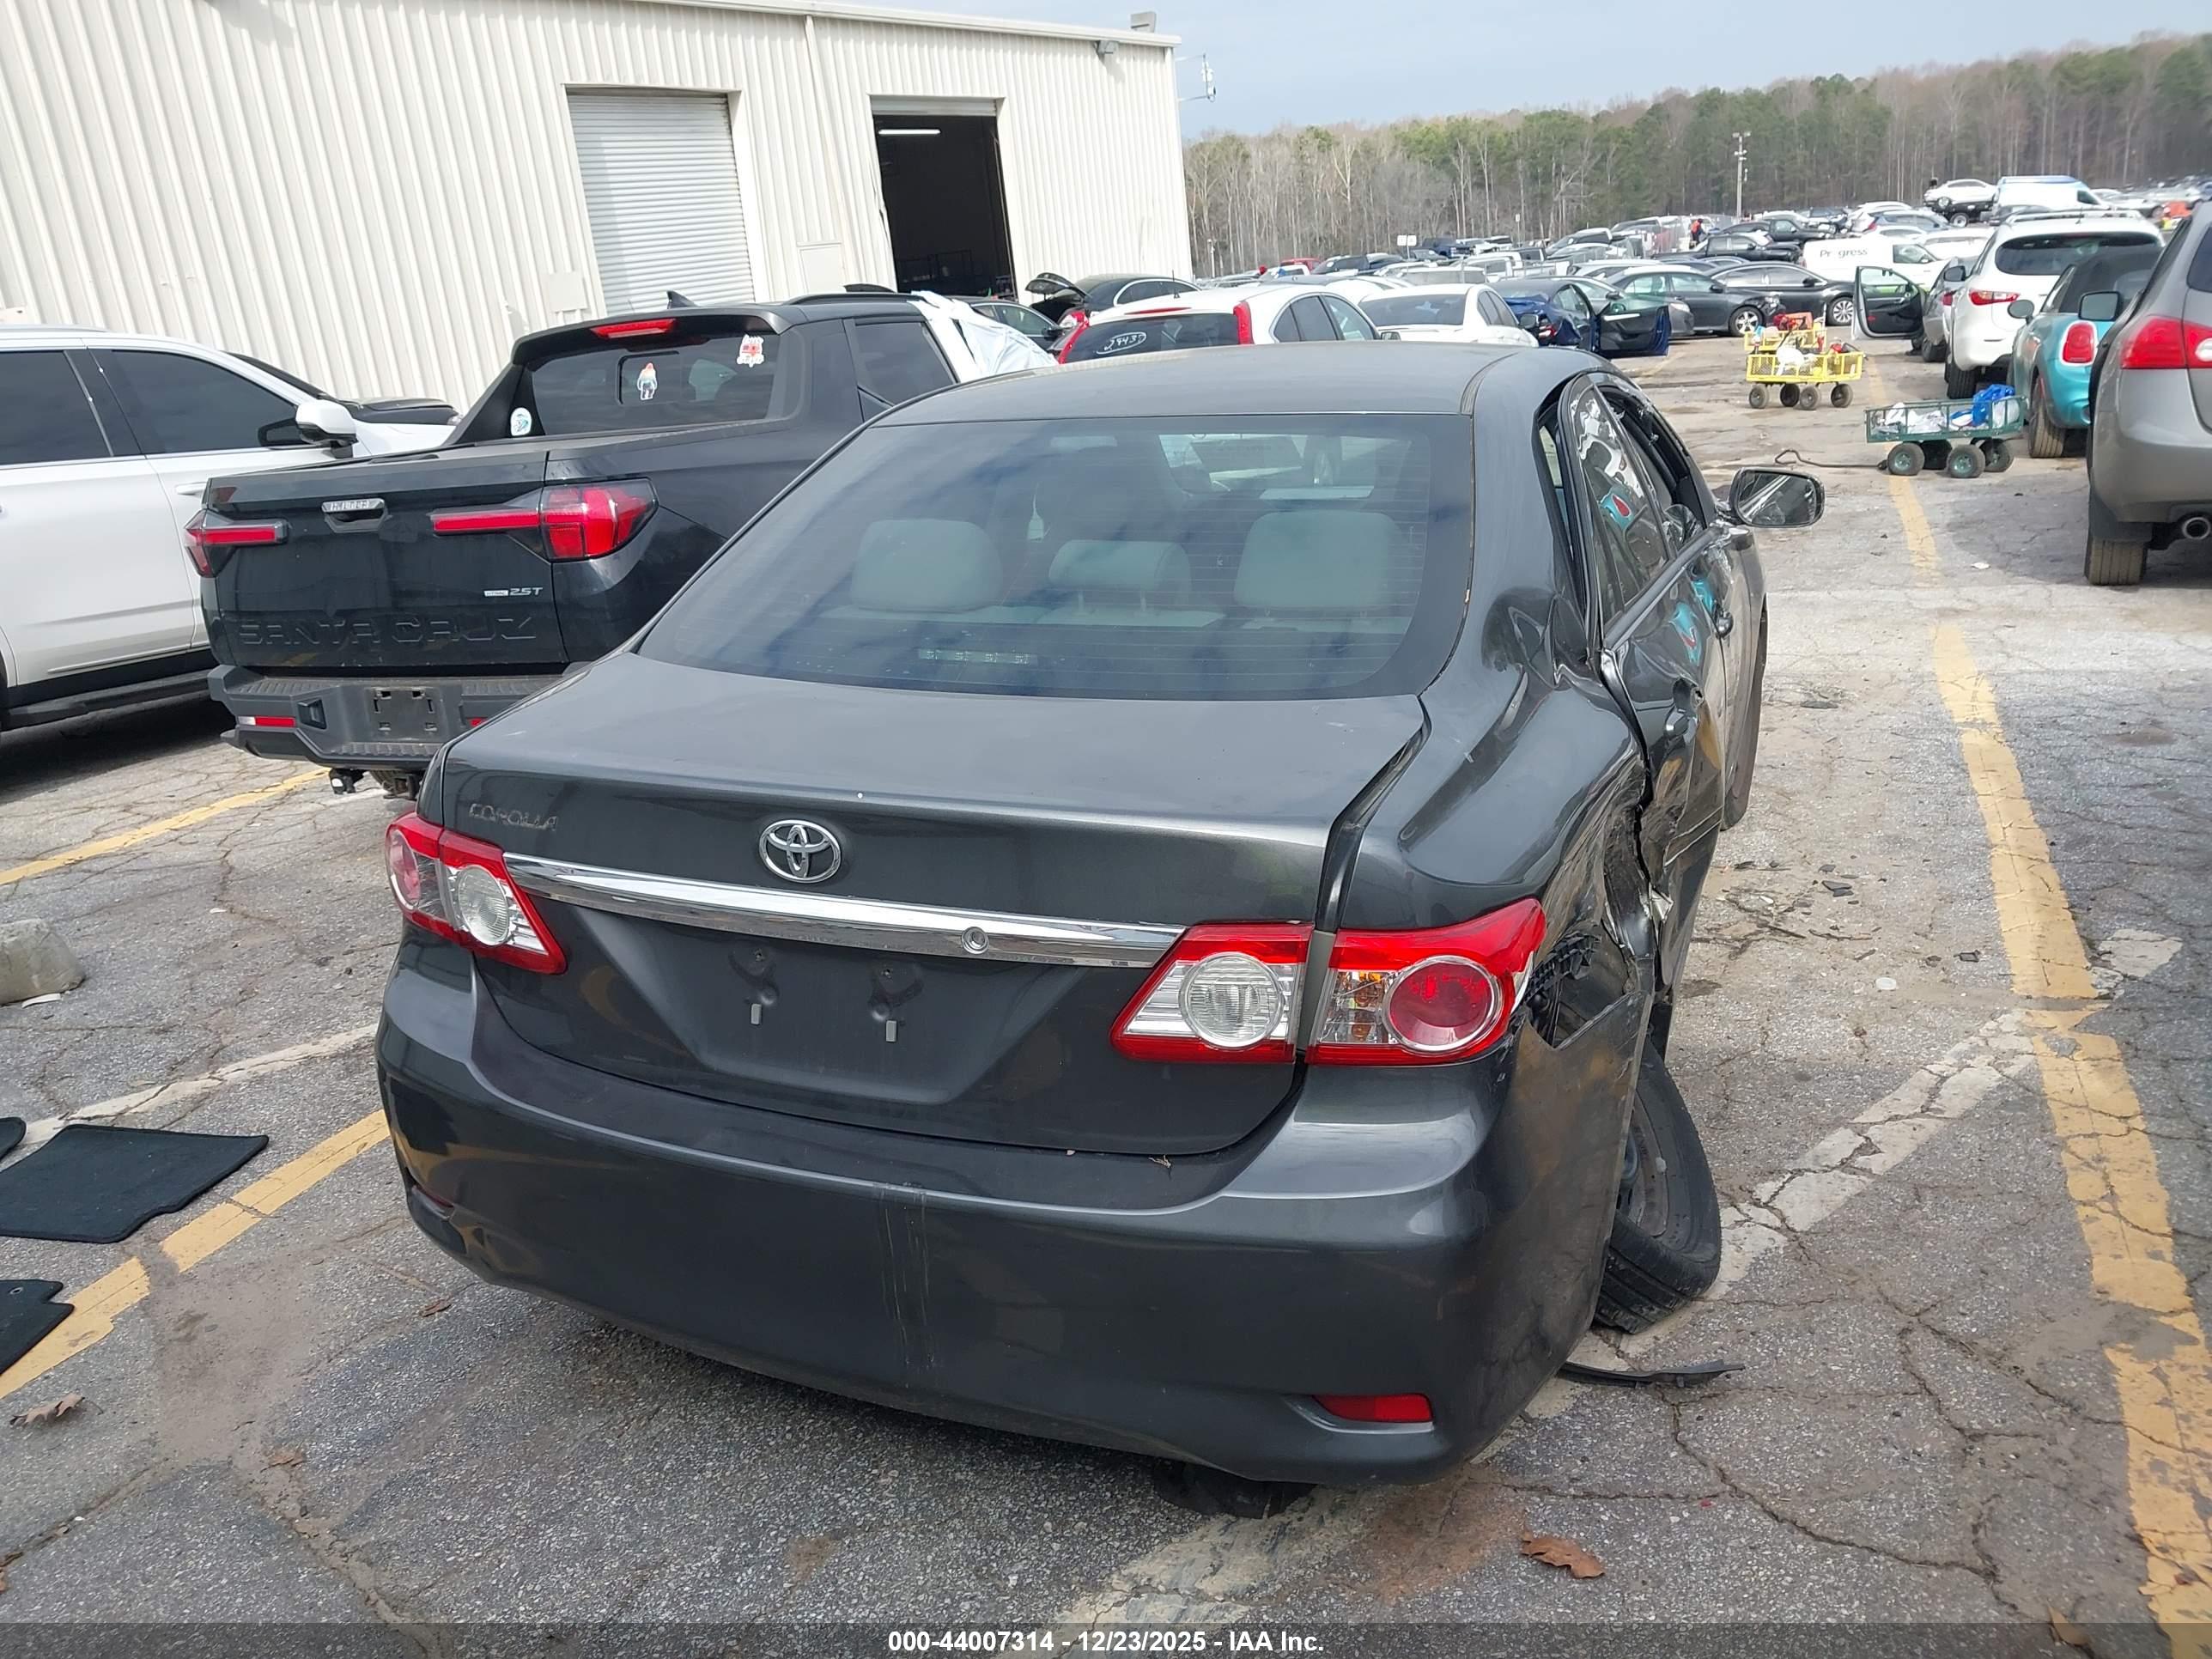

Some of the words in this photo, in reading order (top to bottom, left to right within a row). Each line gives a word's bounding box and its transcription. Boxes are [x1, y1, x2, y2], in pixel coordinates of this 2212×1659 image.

[1820, 249, 1869, 258] Prgress
[240, 620, 380, 644] SANTA
[392, 617, 537, 643] CRUZ
